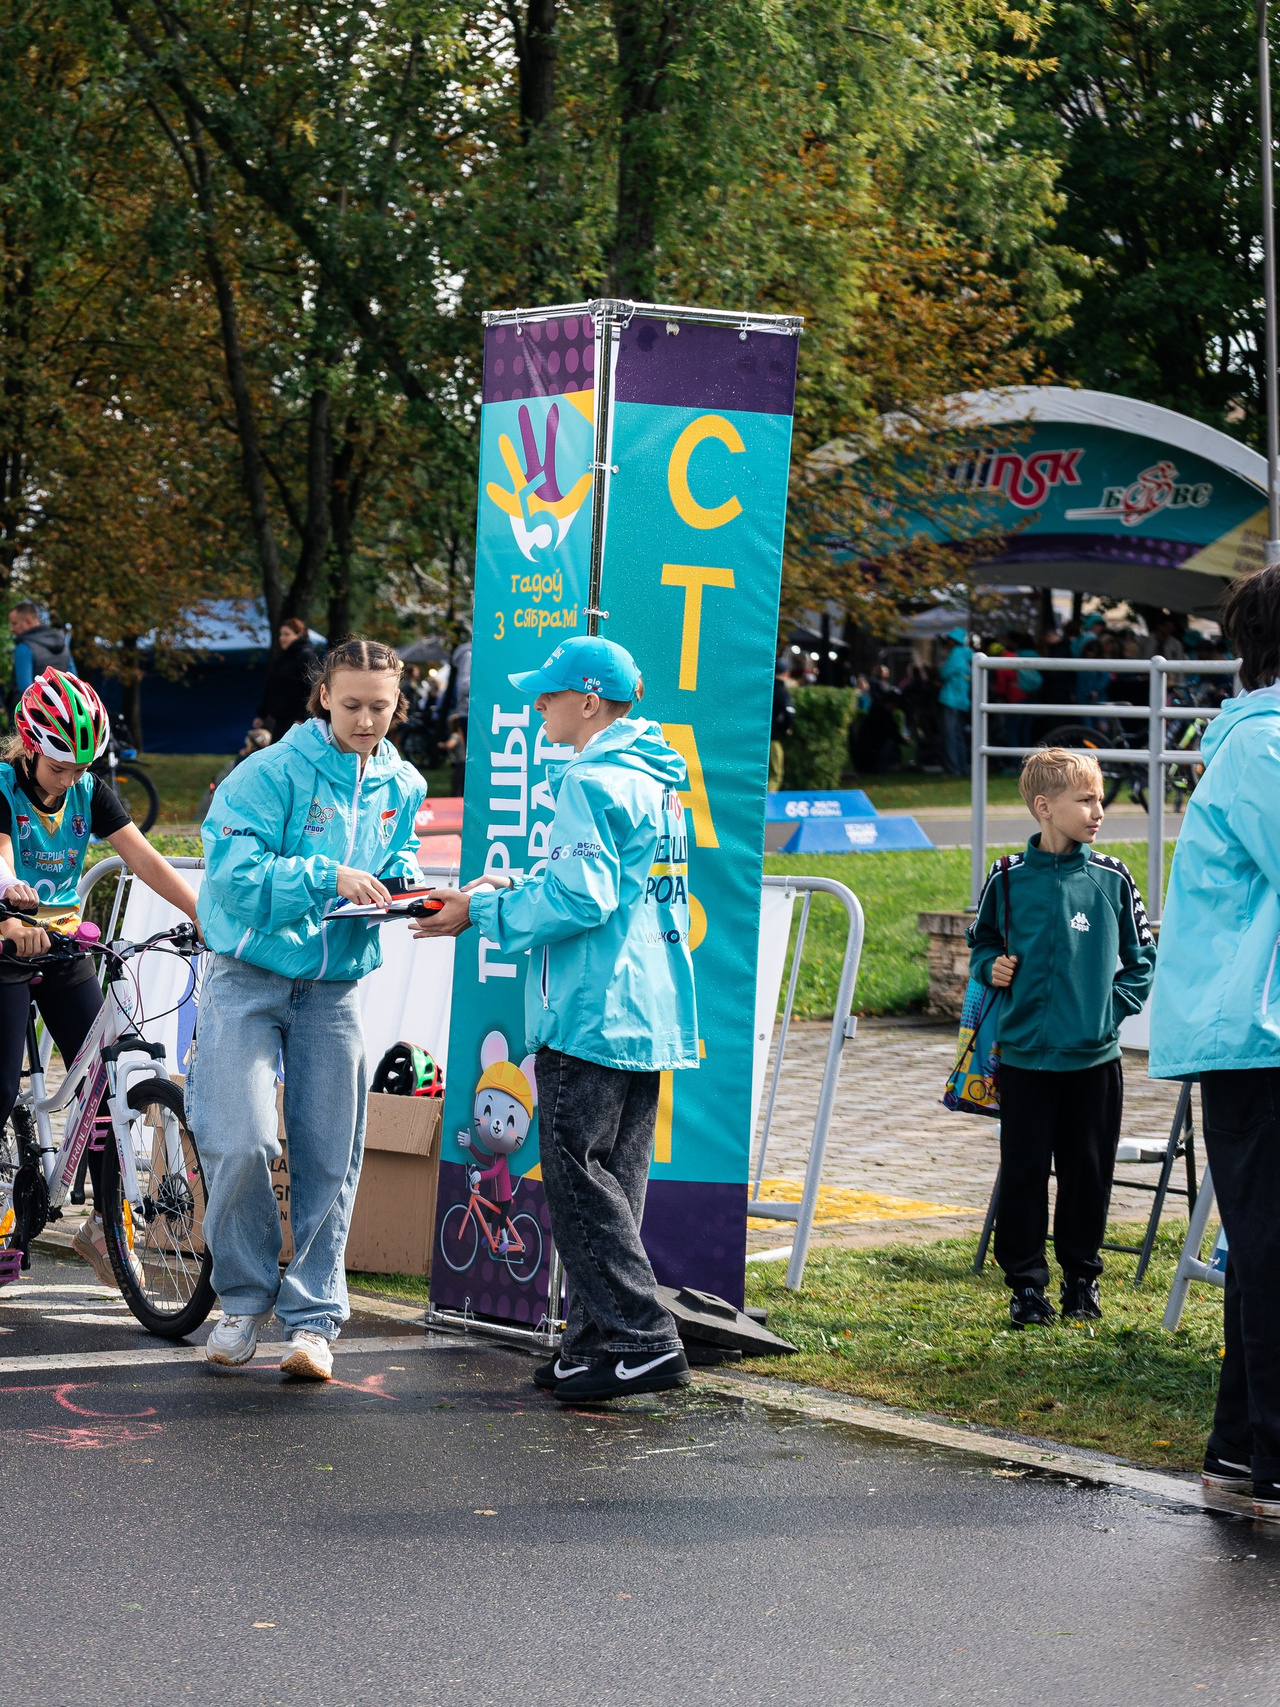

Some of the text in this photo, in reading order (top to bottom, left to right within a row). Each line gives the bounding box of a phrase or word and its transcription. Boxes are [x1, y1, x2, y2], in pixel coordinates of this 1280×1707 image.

[510, 568, 563, 603] гадоў
[513, 603, 578, 638] сябрамі
[35, 849, 65, 861] ПЕРШЫ
[35, 861, 64, 873] РОВАР
[1070, 919, 1090, 932] Kappa
[68, 1097, 98, 1169] PRINCESS
